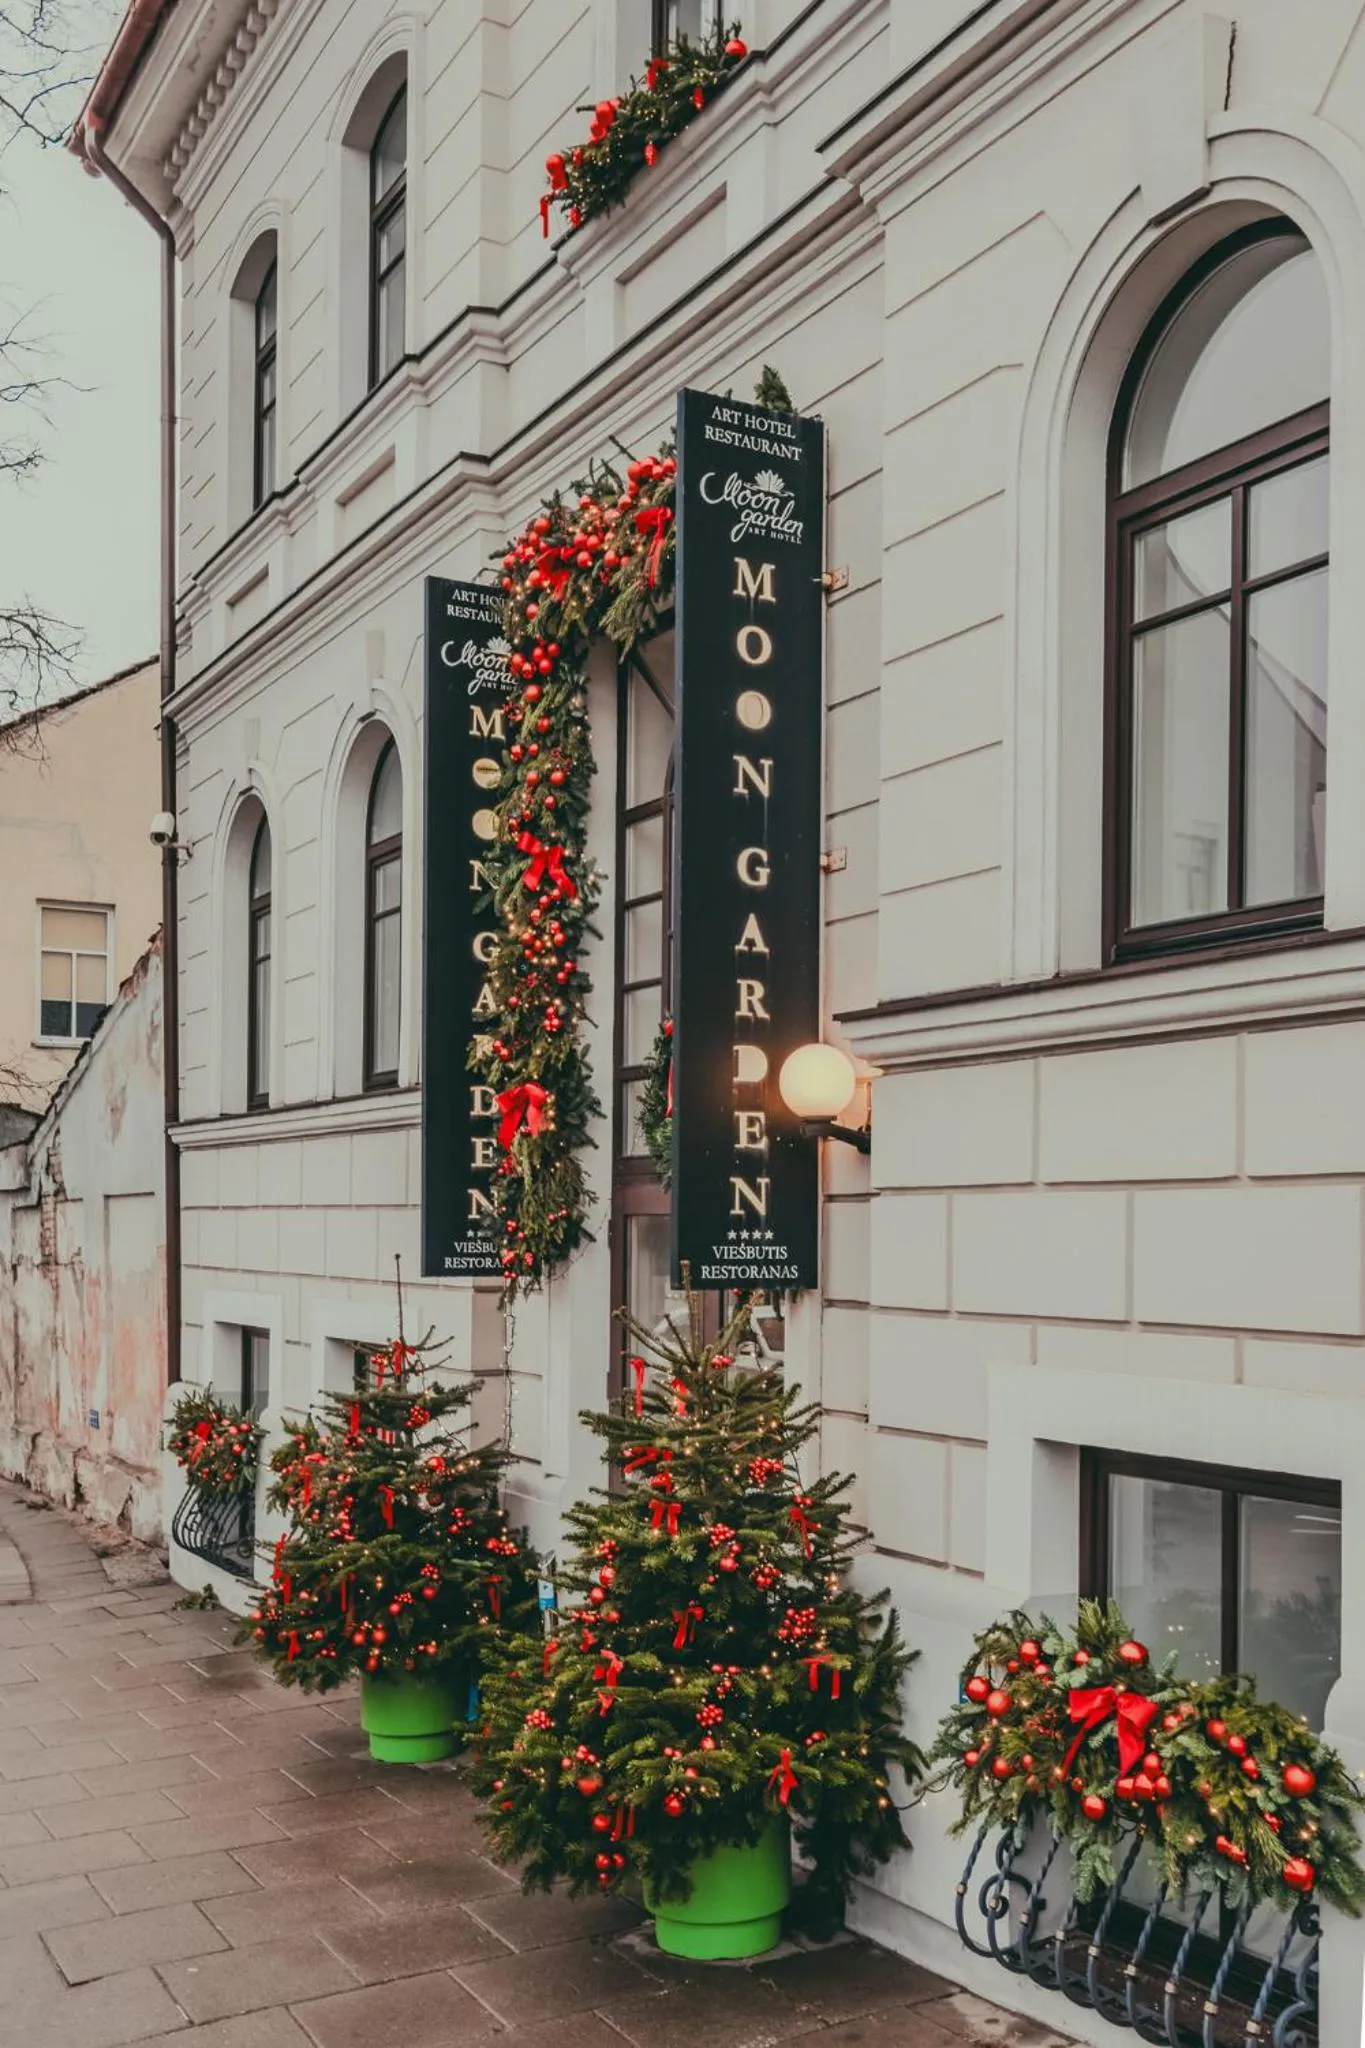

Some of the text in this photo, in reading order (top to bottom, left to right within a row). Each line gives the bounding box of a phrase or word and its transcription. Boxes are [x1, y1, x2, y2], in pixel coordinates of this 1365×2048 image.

[711, 405, 797, 439] ART HOTEL
[704, 425, 802, 461] RESTAURANT
[730, 500, 803, 543] garden
[748, 527, 802, 544] ART HOTEL
[452, 589, 478, 603] ART
[729, 557, 776, 1217] MOON GARDEN
[454, 1239, 498, 1253] VIEŠBU
[712, 1243, 788, 1261] VIEŠBUTIS
[444, 1256, 505, 1269] RESTORA
[701, 1265, 799, 1280] RESTORANAS
